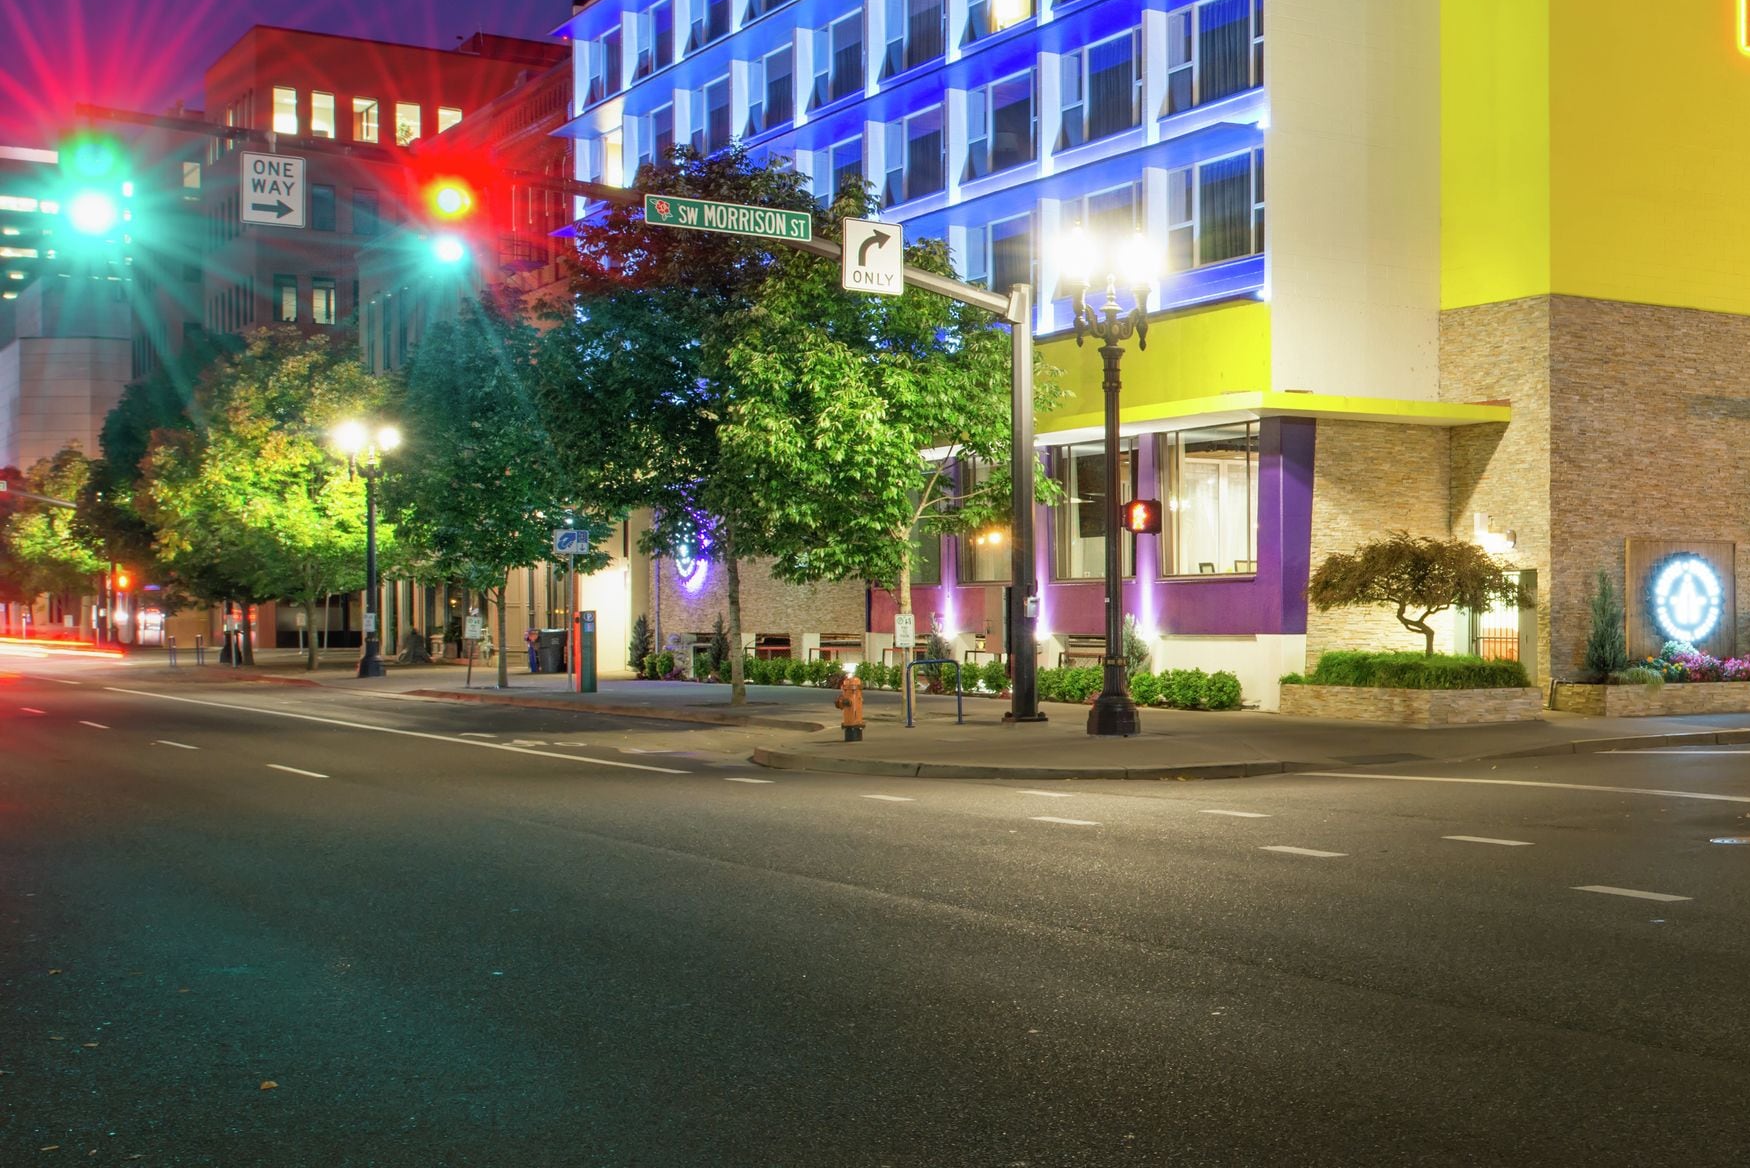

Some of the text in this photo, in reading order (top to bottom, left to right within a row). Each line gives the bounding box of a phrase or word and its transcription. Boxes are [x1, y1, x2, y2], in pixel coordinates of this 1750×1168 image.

[253, 159, 294, 178] ONE
[252, 178, 295, 196] WAY
[678, 204, 806, 238] SW MORRISON ST
[852, 270, 894, 287] ONLY
